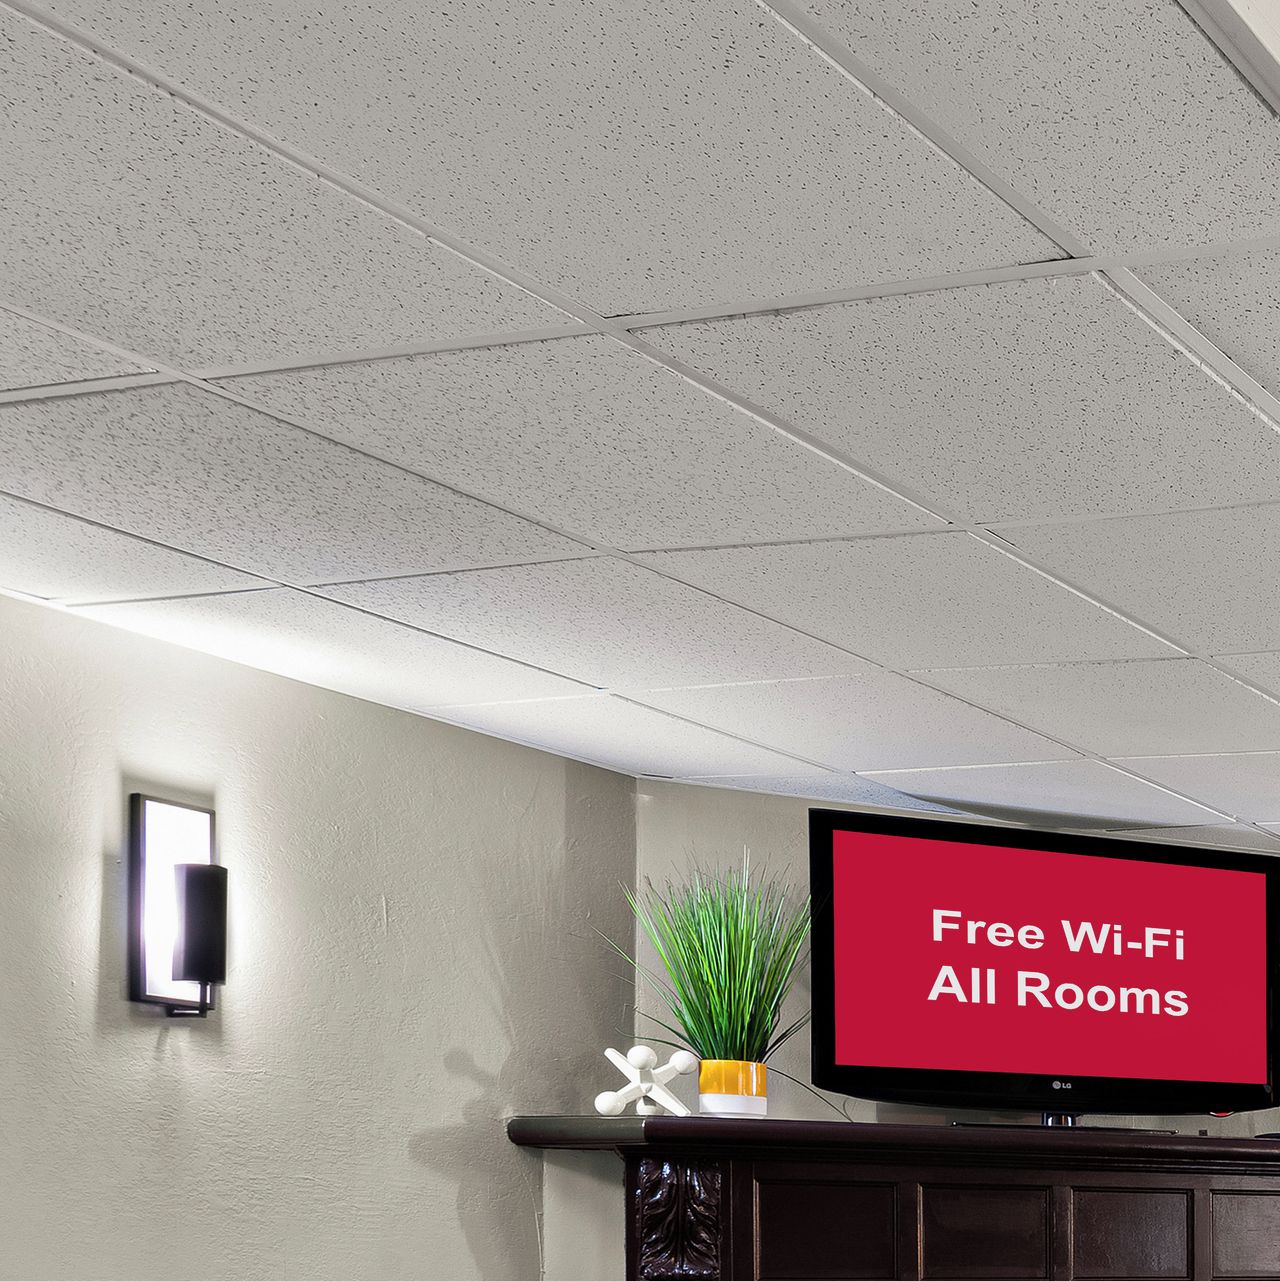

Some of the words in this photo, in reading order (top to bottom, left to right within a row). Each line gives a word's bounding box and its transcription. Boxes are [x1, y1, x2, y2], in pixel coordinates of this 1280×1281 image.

[932, 908, 1045, 950] Free
[1060, 919, 1185, 960] Wi-Fi
[927, 965, 996, 1005] All
[1017, 970, 1189, 1017] Rooms
